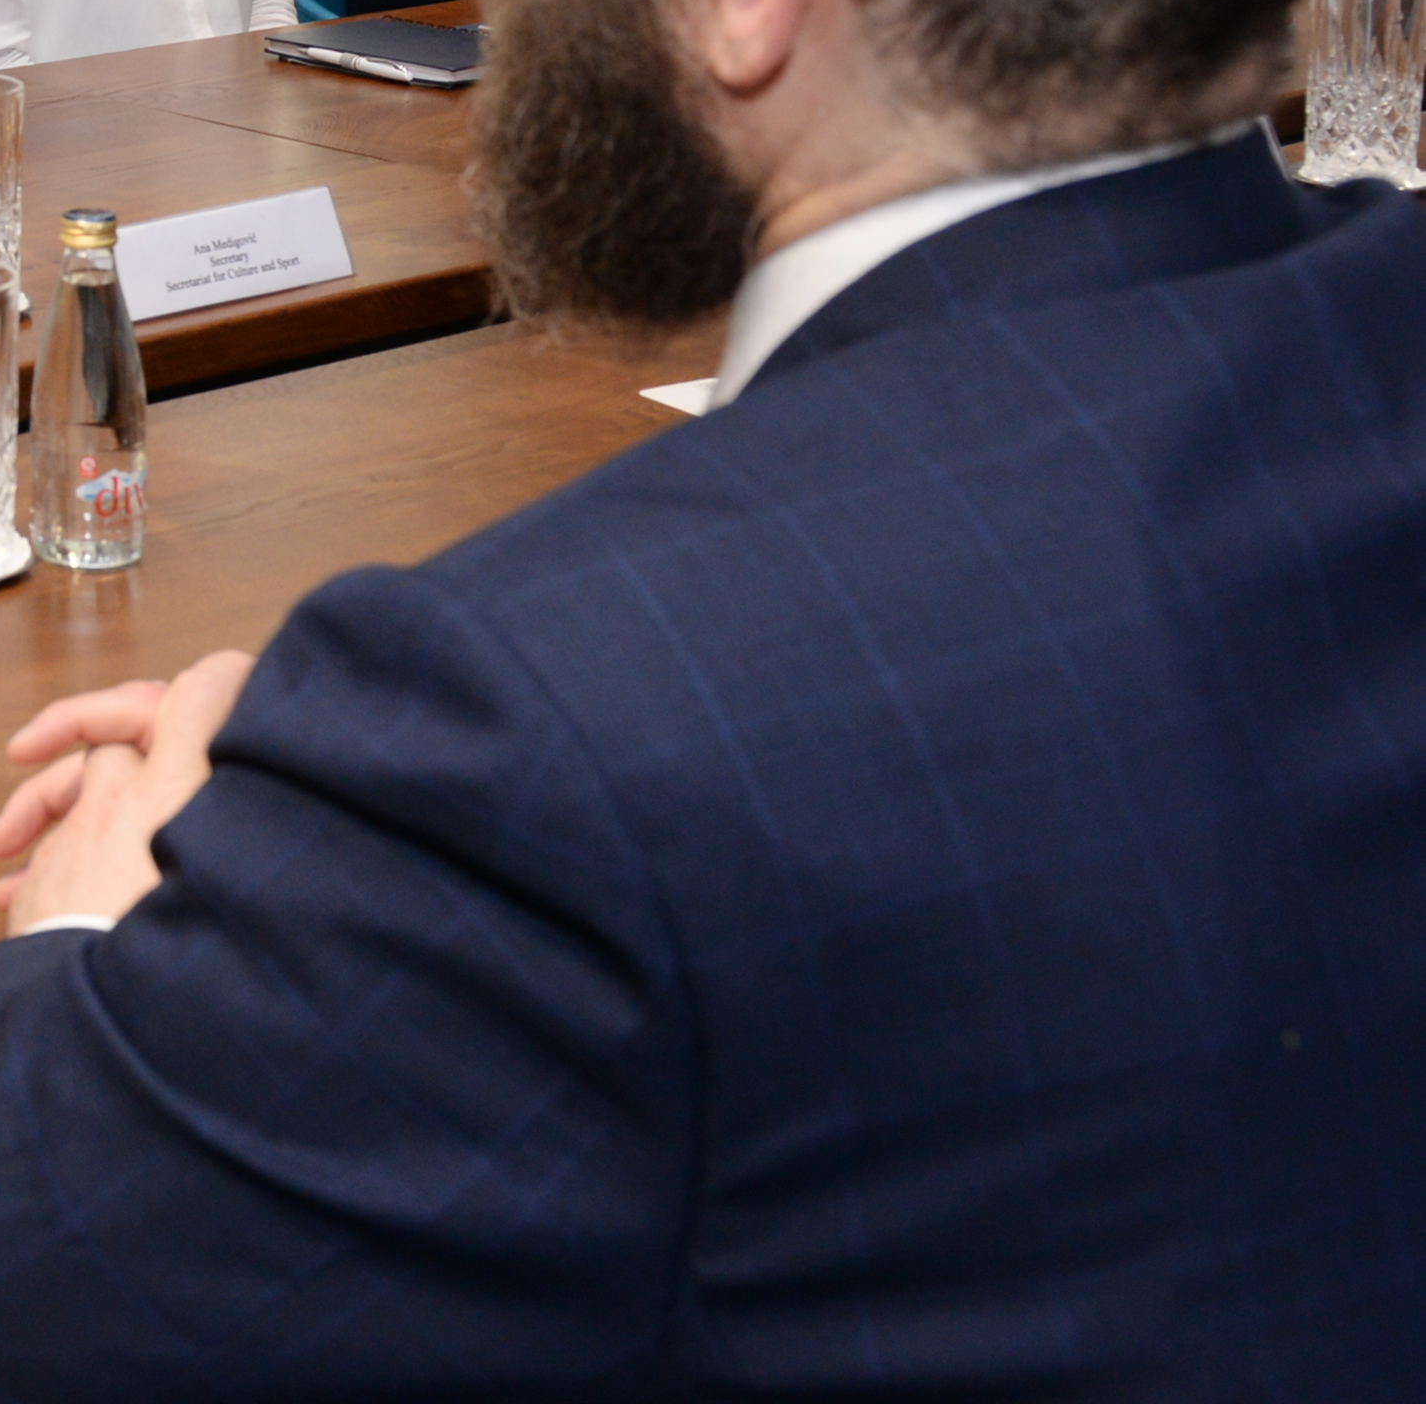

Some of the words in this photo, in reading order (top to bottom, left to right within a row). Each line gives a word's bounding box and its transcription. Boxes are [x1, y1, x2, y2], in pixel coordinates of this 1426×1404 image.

[193, 244, 211, 255] Ana
[209, 252, 249, 267] Secretary
[165, 274, 212, 292] Secretariat
[212, 271, 226, 282] for
[227, 266, 259, 280] Culture
[261, 259, 276, 272] and
[276, 256, 300, 271] Sport
